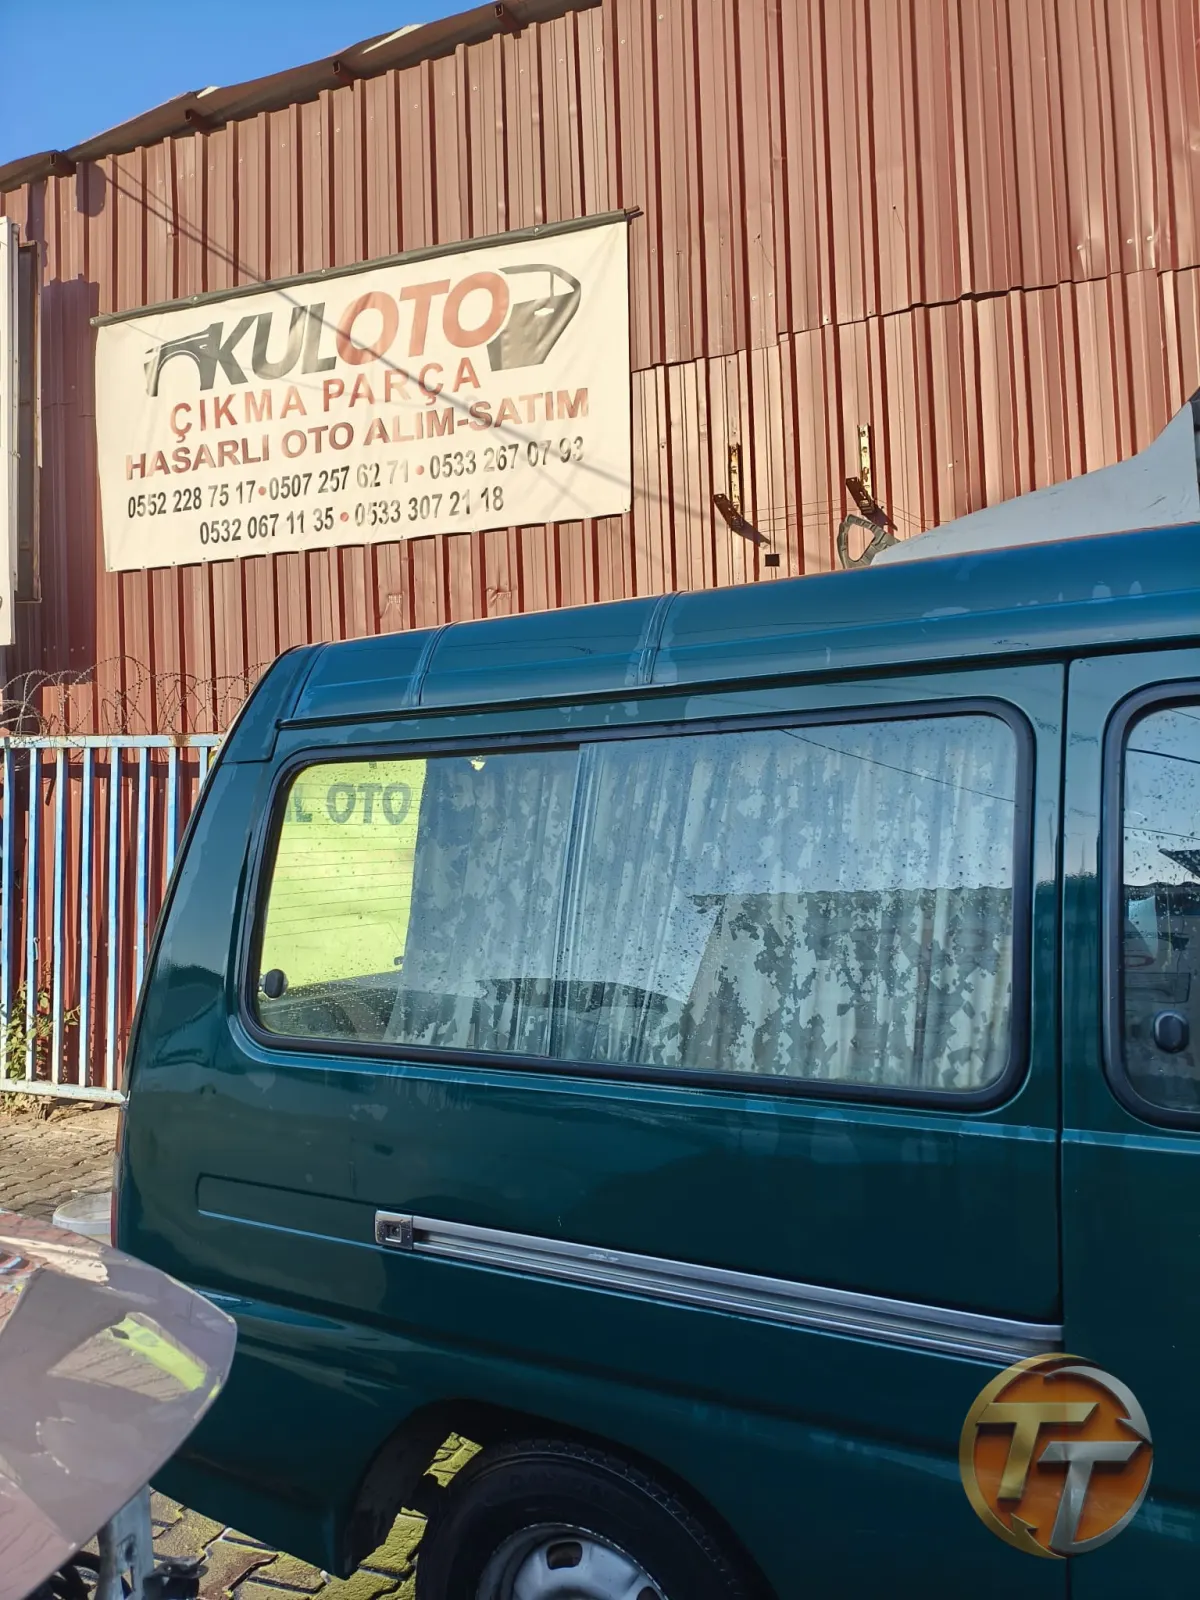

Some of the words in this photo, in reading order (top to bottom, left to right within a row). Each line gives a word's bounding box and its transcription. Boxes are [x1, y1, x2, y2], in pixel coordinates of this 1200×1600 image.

[125, 434, 270, 481] HASARLI
[281, 421, 354, 459] OTO
[363, 387, 590, 446] ALIM-SATIM
[169, 385, 307, 443] ÇIKMA
[323, 357, 481, 412] PARÇA
[127, 491, 167, 519] 0552
[172, 487, 202, 513] 228
[208, 483, 229, 508] 75
[235, 480, 256, 504] 17
[269, 472, 313, 501] 0507
[318, 465, 350, 494] 257
[356, 462, 381, 489] 62
[386, 459, 409, 484] 71
[429, 450, 477, 480] 0533
[483, 443, 519, 473] 267
[526, 439, 552, 467] 07
[558, 436, 584, 463] 93
[199, 518, 242, 545] 0532
[247, 513, 279, 539] 067
[285, 509, 305, 535] 11
[313, 506, 335, 532] 35
[354, 499, 401, 527] 0533
[408, 493, 443, 521] 307
[449, 489, 471, 517] 21
[480, 485, 504, 513] 18
[326, 781, 412, 825] OTO
